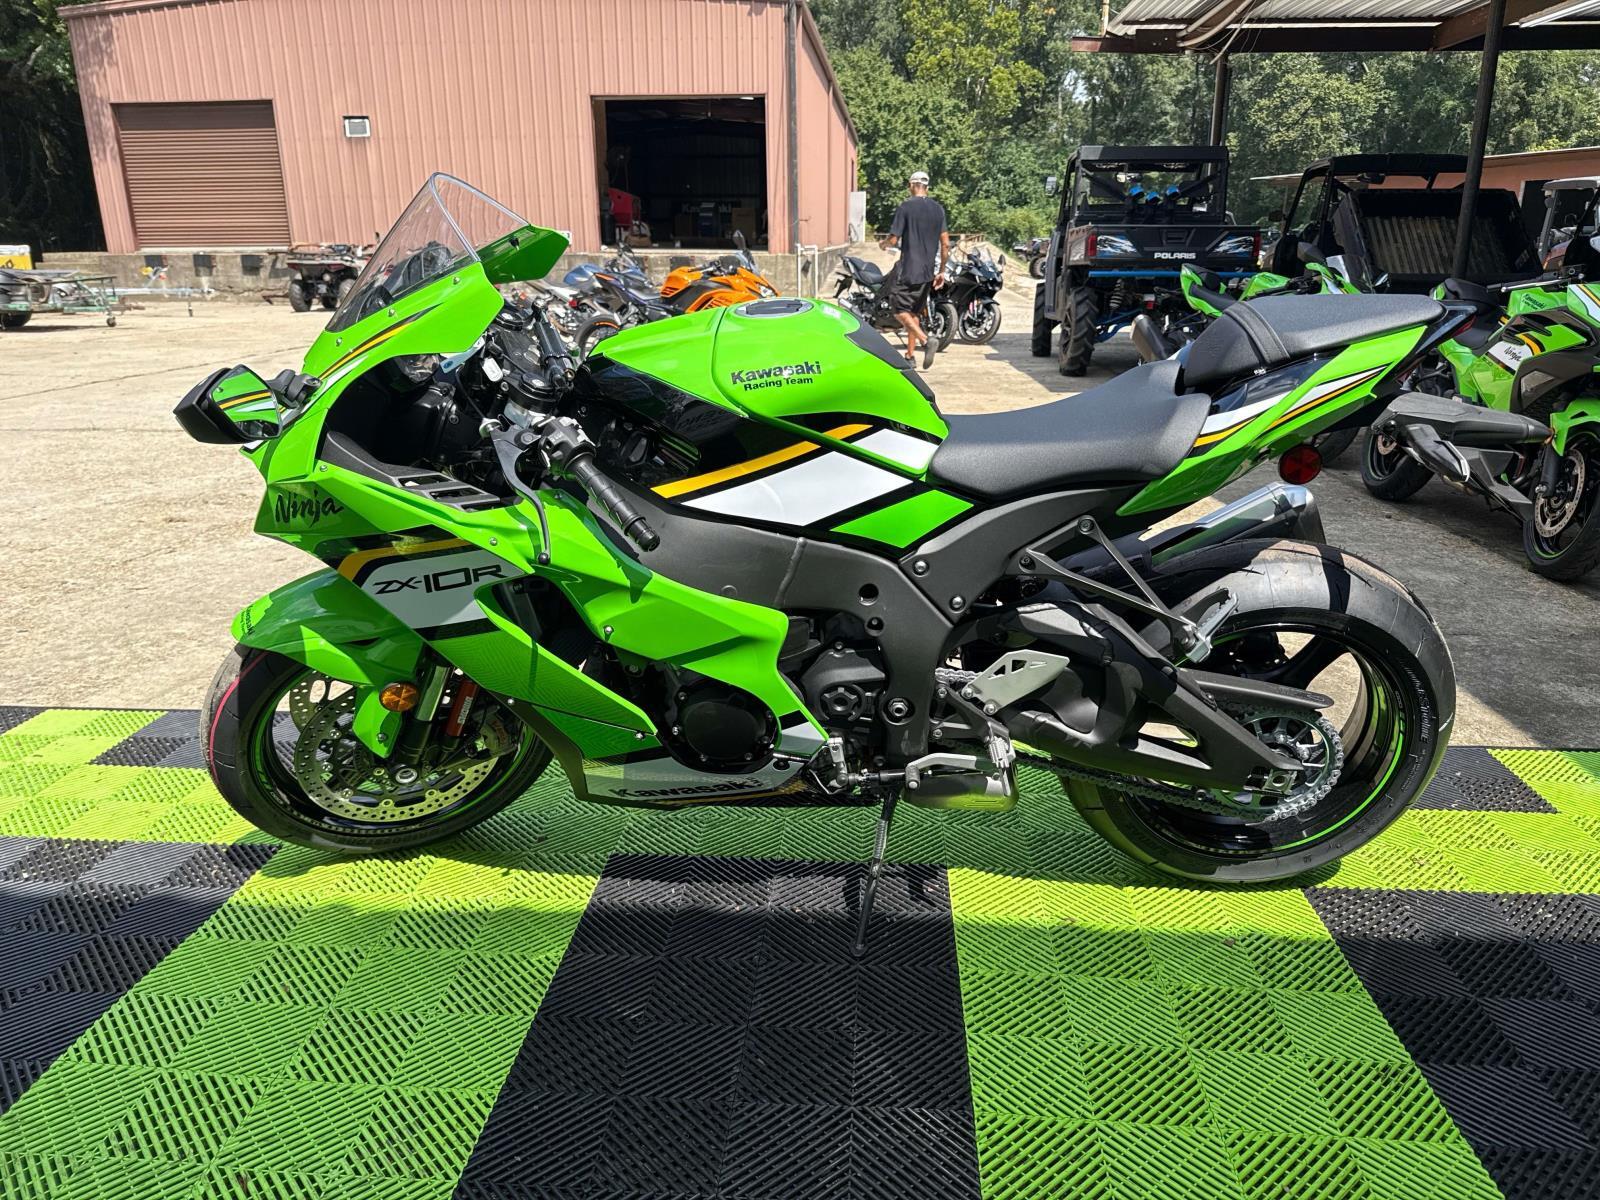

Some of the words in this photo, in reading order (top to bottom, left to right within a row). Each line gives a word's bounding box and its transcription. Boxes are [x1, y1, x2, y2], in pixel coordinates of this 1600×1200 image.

[1154, 252, 1197, 260] POLARIS
[1504, 346, 1522, 361] Ninja
[731, 361, 822, 384] Kawasaki
[744, 379, 783, 391] Racing
[784, 376, 814, 385] Team
[275, 489, 345, 528] Ninja
[373, 564, 508, 595] ZX-10R
[608, 777, 765, 798] Kawasaki
